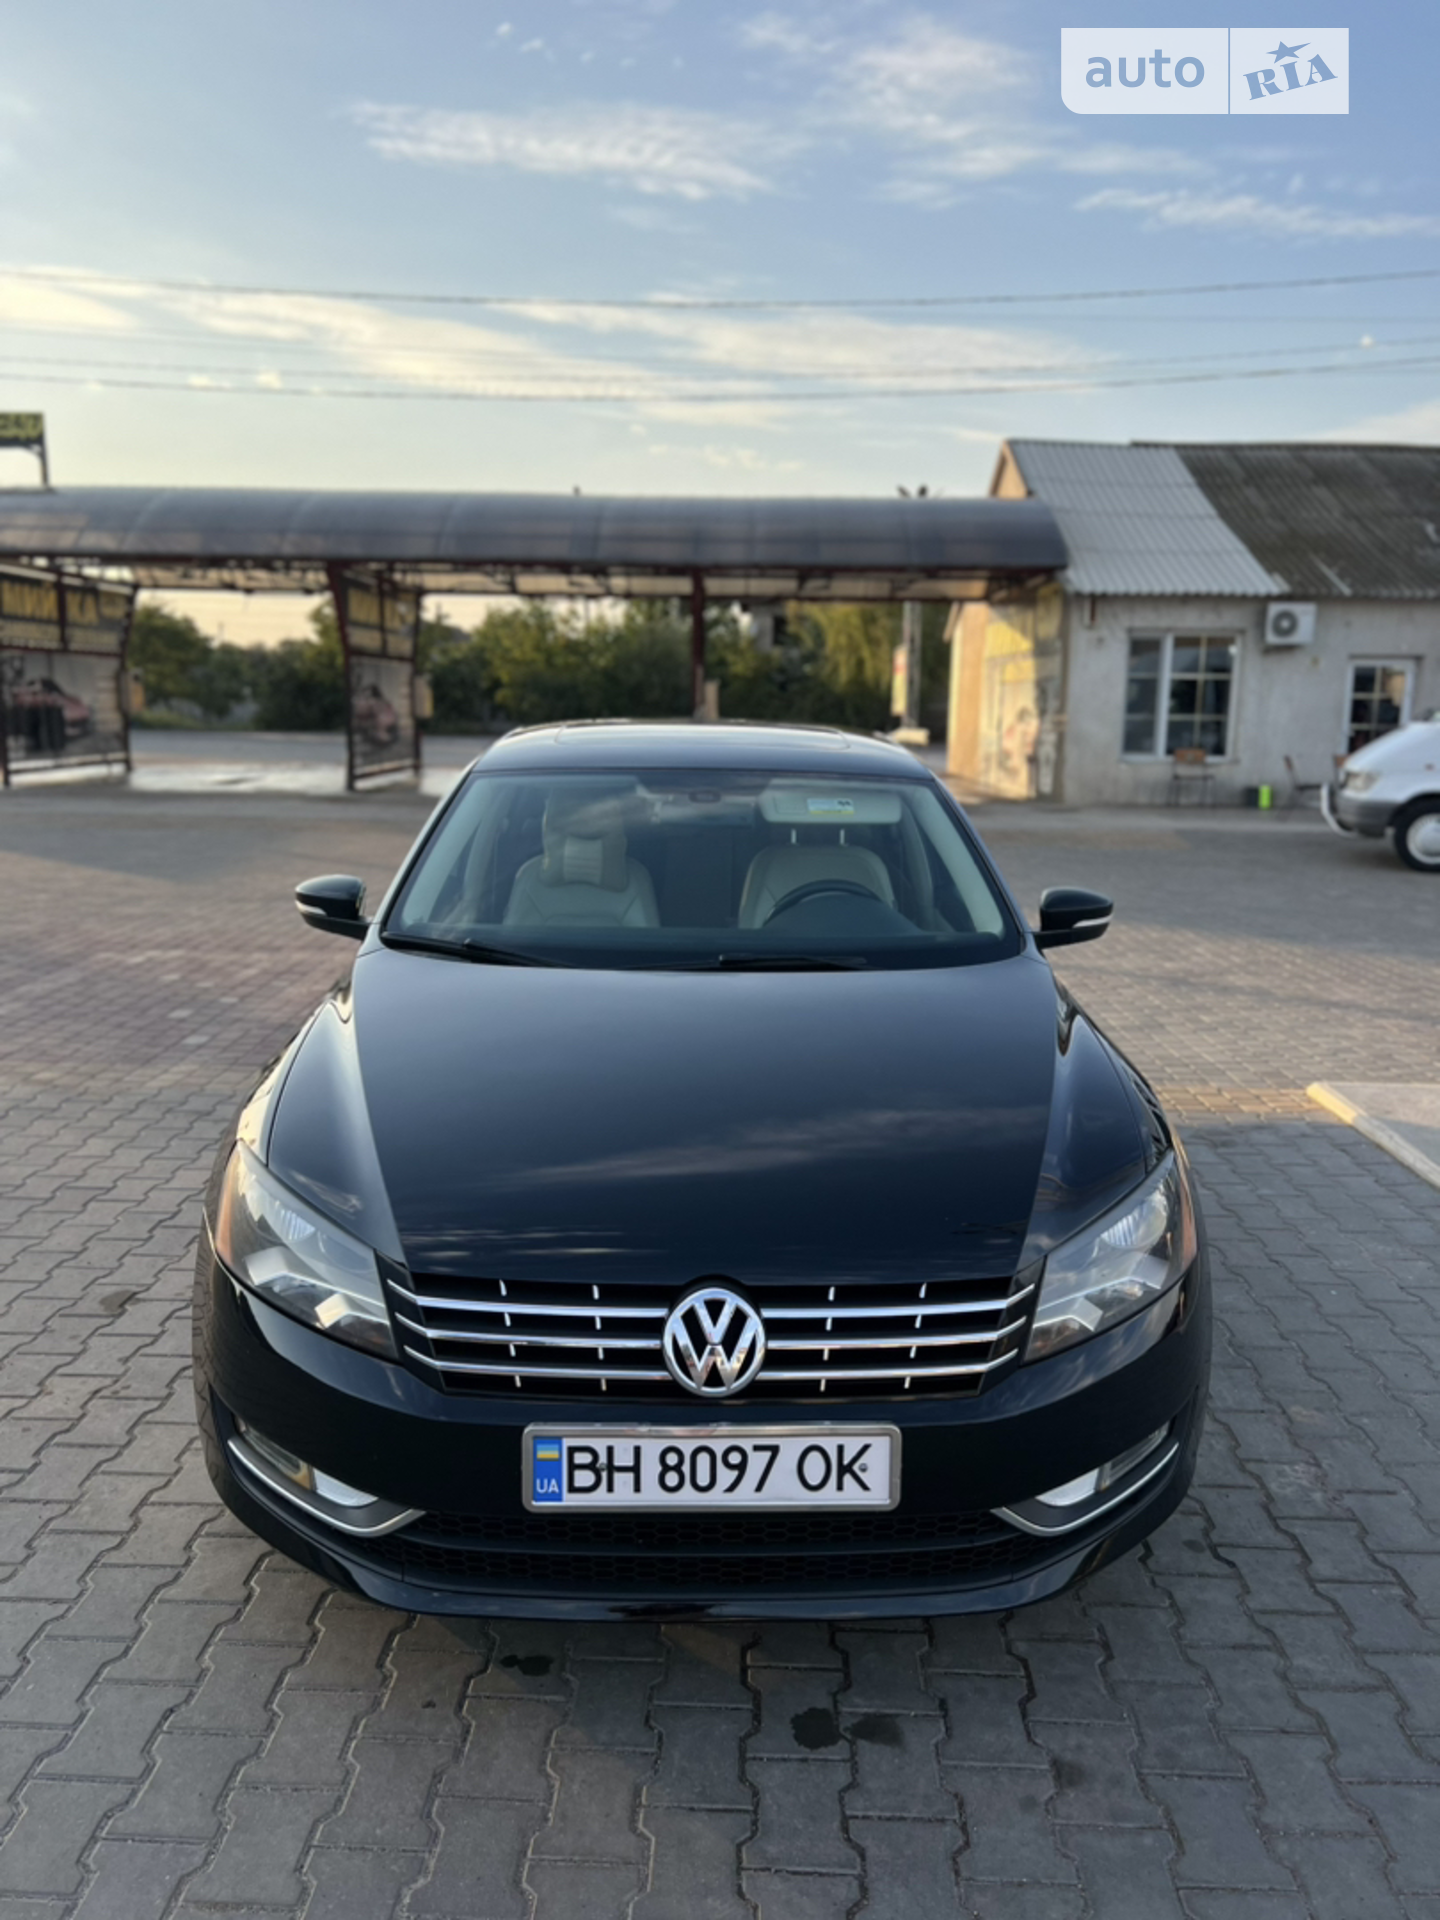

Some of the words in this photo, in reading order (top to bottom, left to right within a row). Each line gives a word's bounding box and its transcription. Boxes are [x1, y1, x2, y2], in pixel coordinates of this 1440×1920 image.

[567, 1446, 641, 1494] BH
[657, 1445, 780, 1494] 8097
[796, 1444, 872, 1493] OK
[536, 1478, 559, 1494] UA
